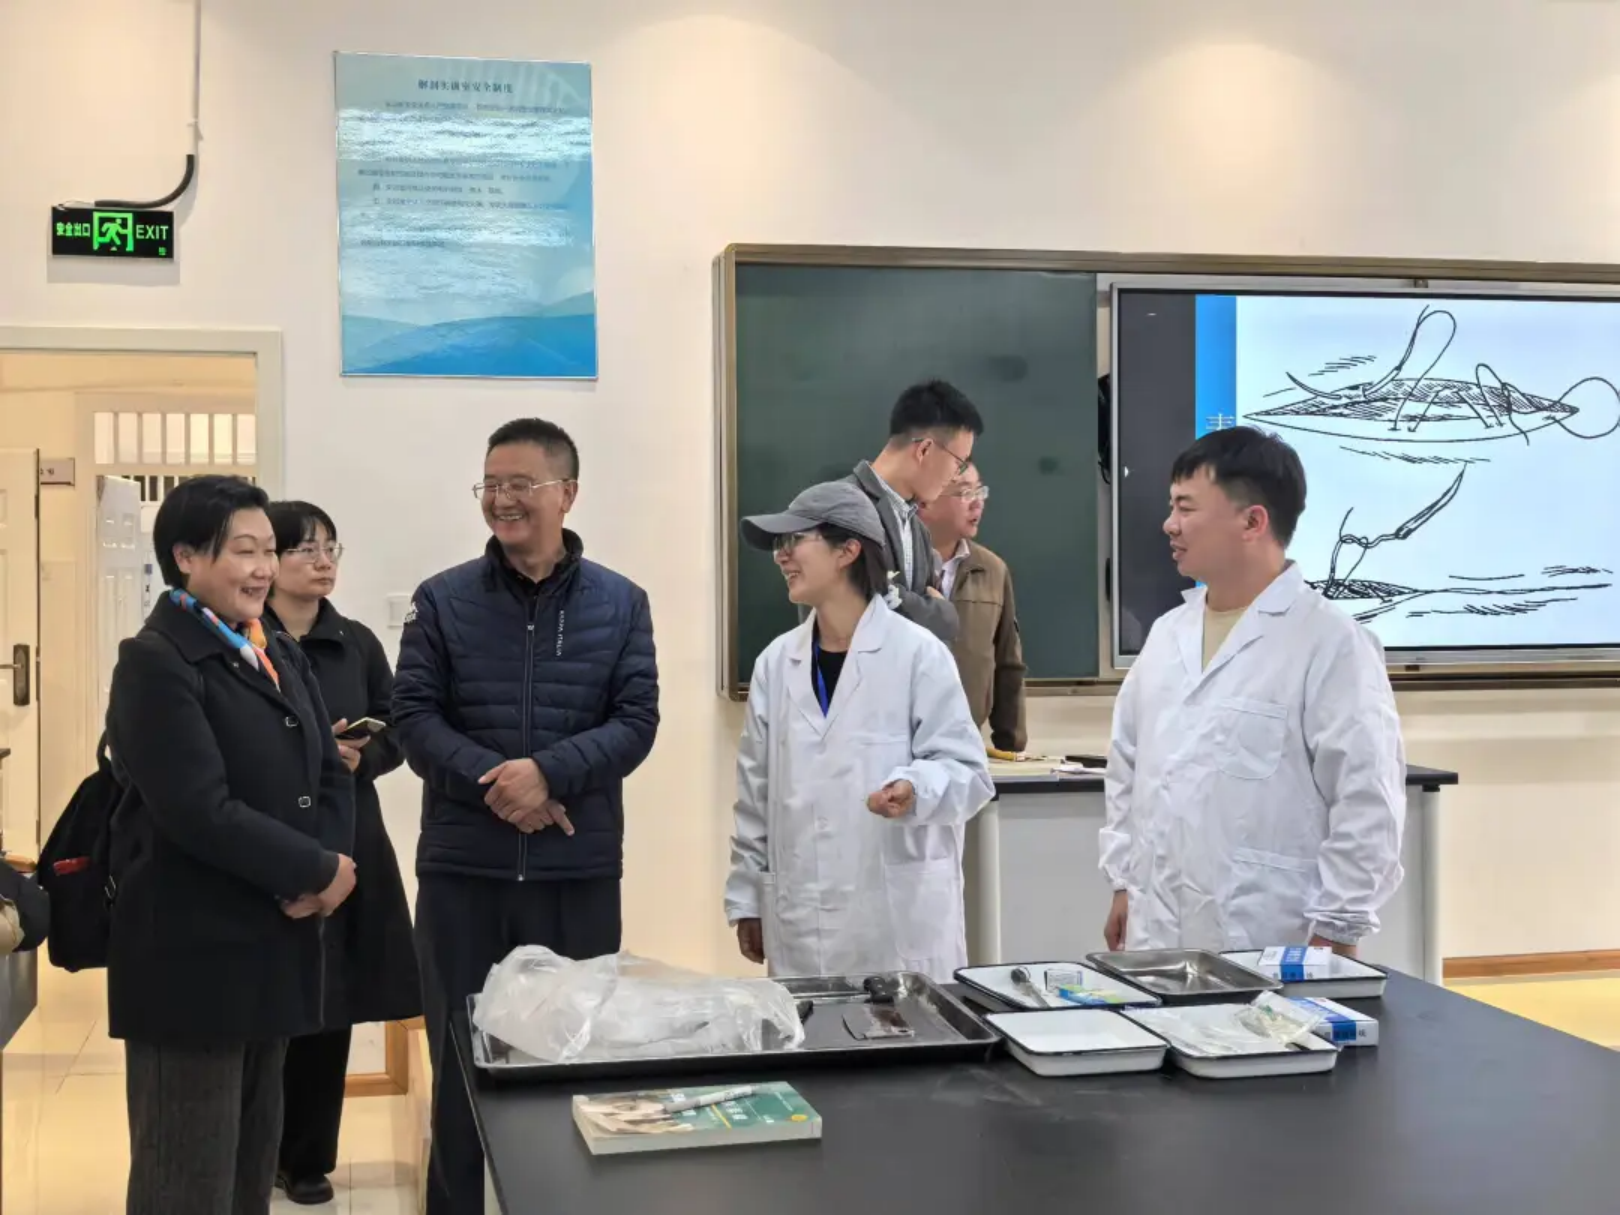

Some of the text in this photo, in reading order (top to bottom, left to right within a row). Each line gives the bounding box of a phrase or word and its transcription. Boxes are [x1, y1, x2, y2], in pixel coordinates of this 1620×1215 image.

[56, 222, 91, 237] 安全出口
[135, 224, 169, 240] EXIT
